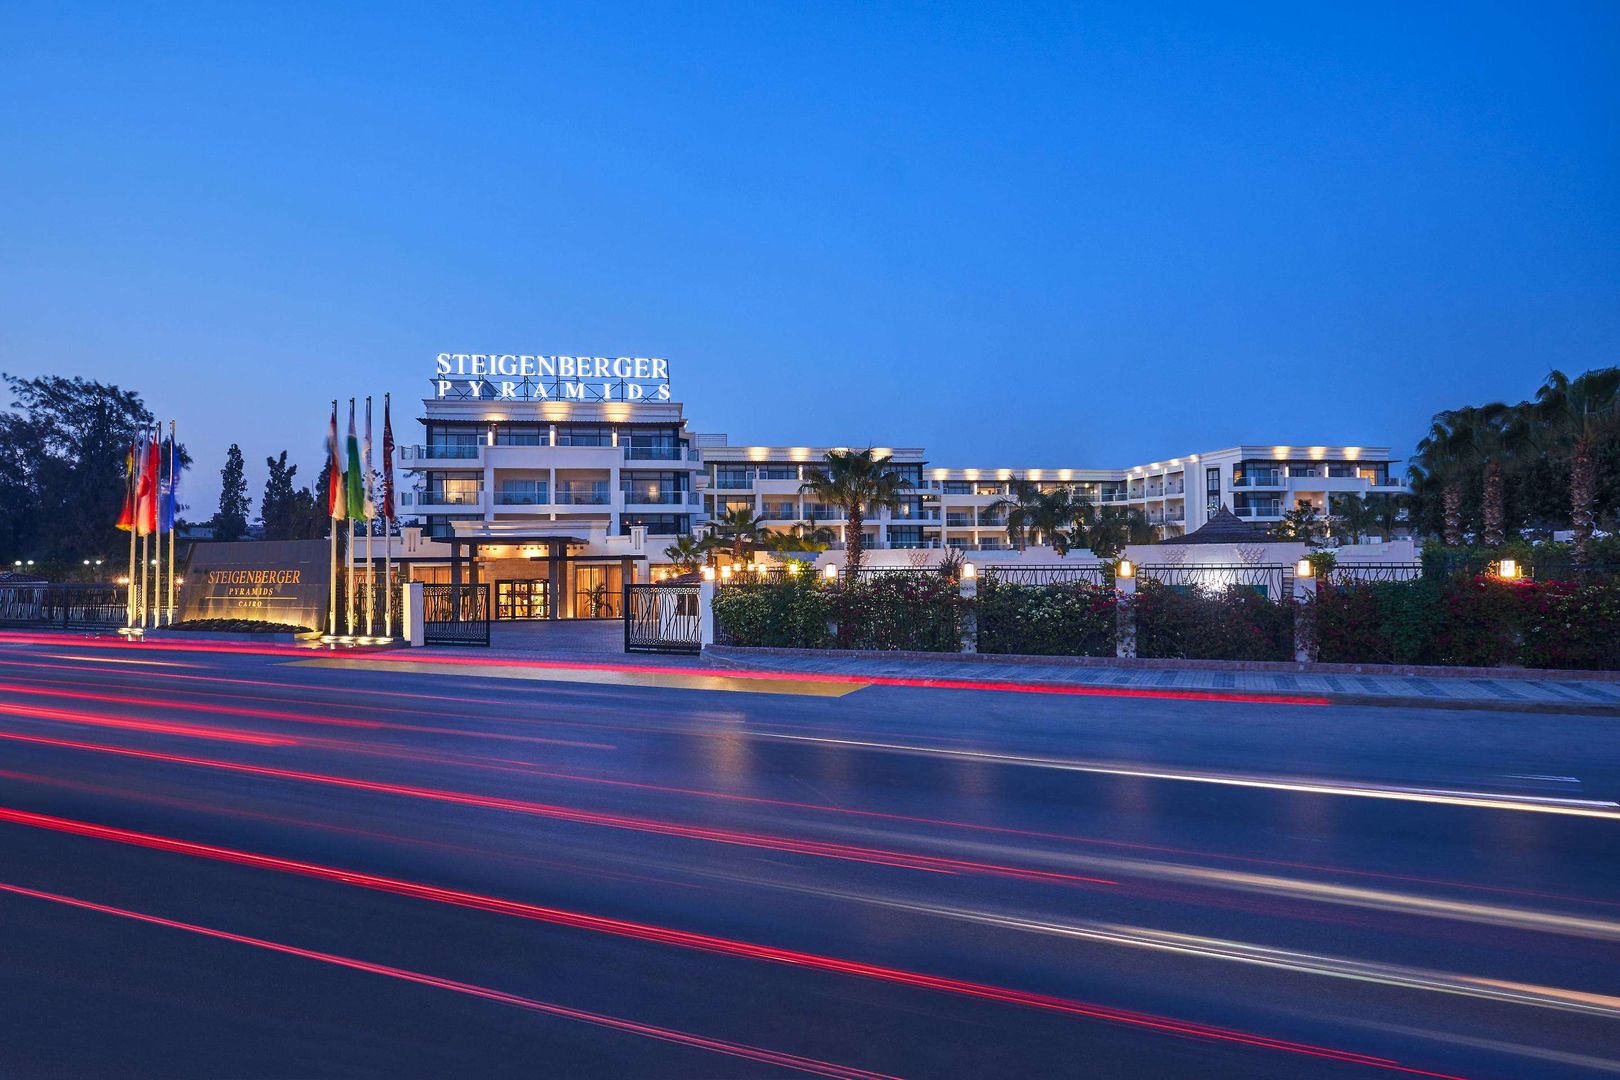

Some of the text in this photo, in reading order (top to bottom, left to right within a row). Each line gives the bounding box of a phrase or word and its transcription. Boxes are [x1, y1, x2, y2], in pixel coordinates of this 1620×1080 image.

[436, 353, 669, 378] STEIGENBERGER
[437, 380, 671, 400] PYRAMIDS
[208, 570, 301, 584] STEIGENBERGER
[229, 587, 274, 596] PYRAMIDS
